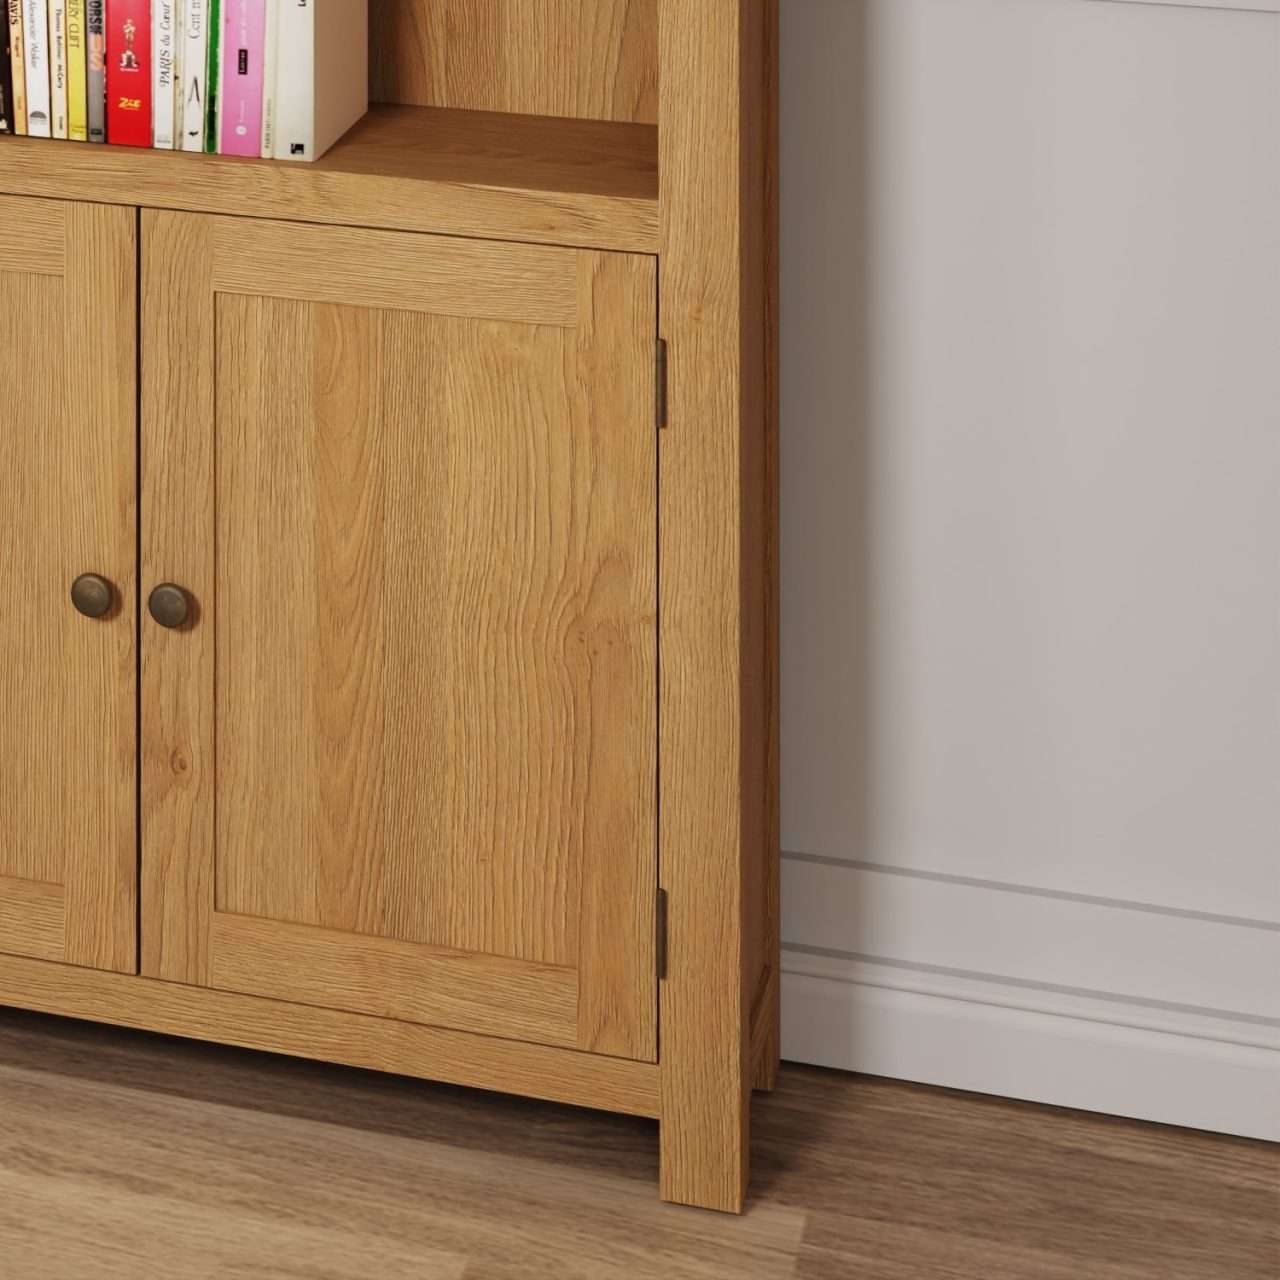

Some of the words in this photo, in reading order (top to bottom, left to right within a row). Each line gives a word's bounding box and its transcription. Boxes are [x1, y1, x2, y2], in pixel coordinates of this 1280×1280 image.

[69, 23, 80, 49] CLIFT
[187, 13, 201, 39] Cent
[160, 49, 172, 87] PARIS
